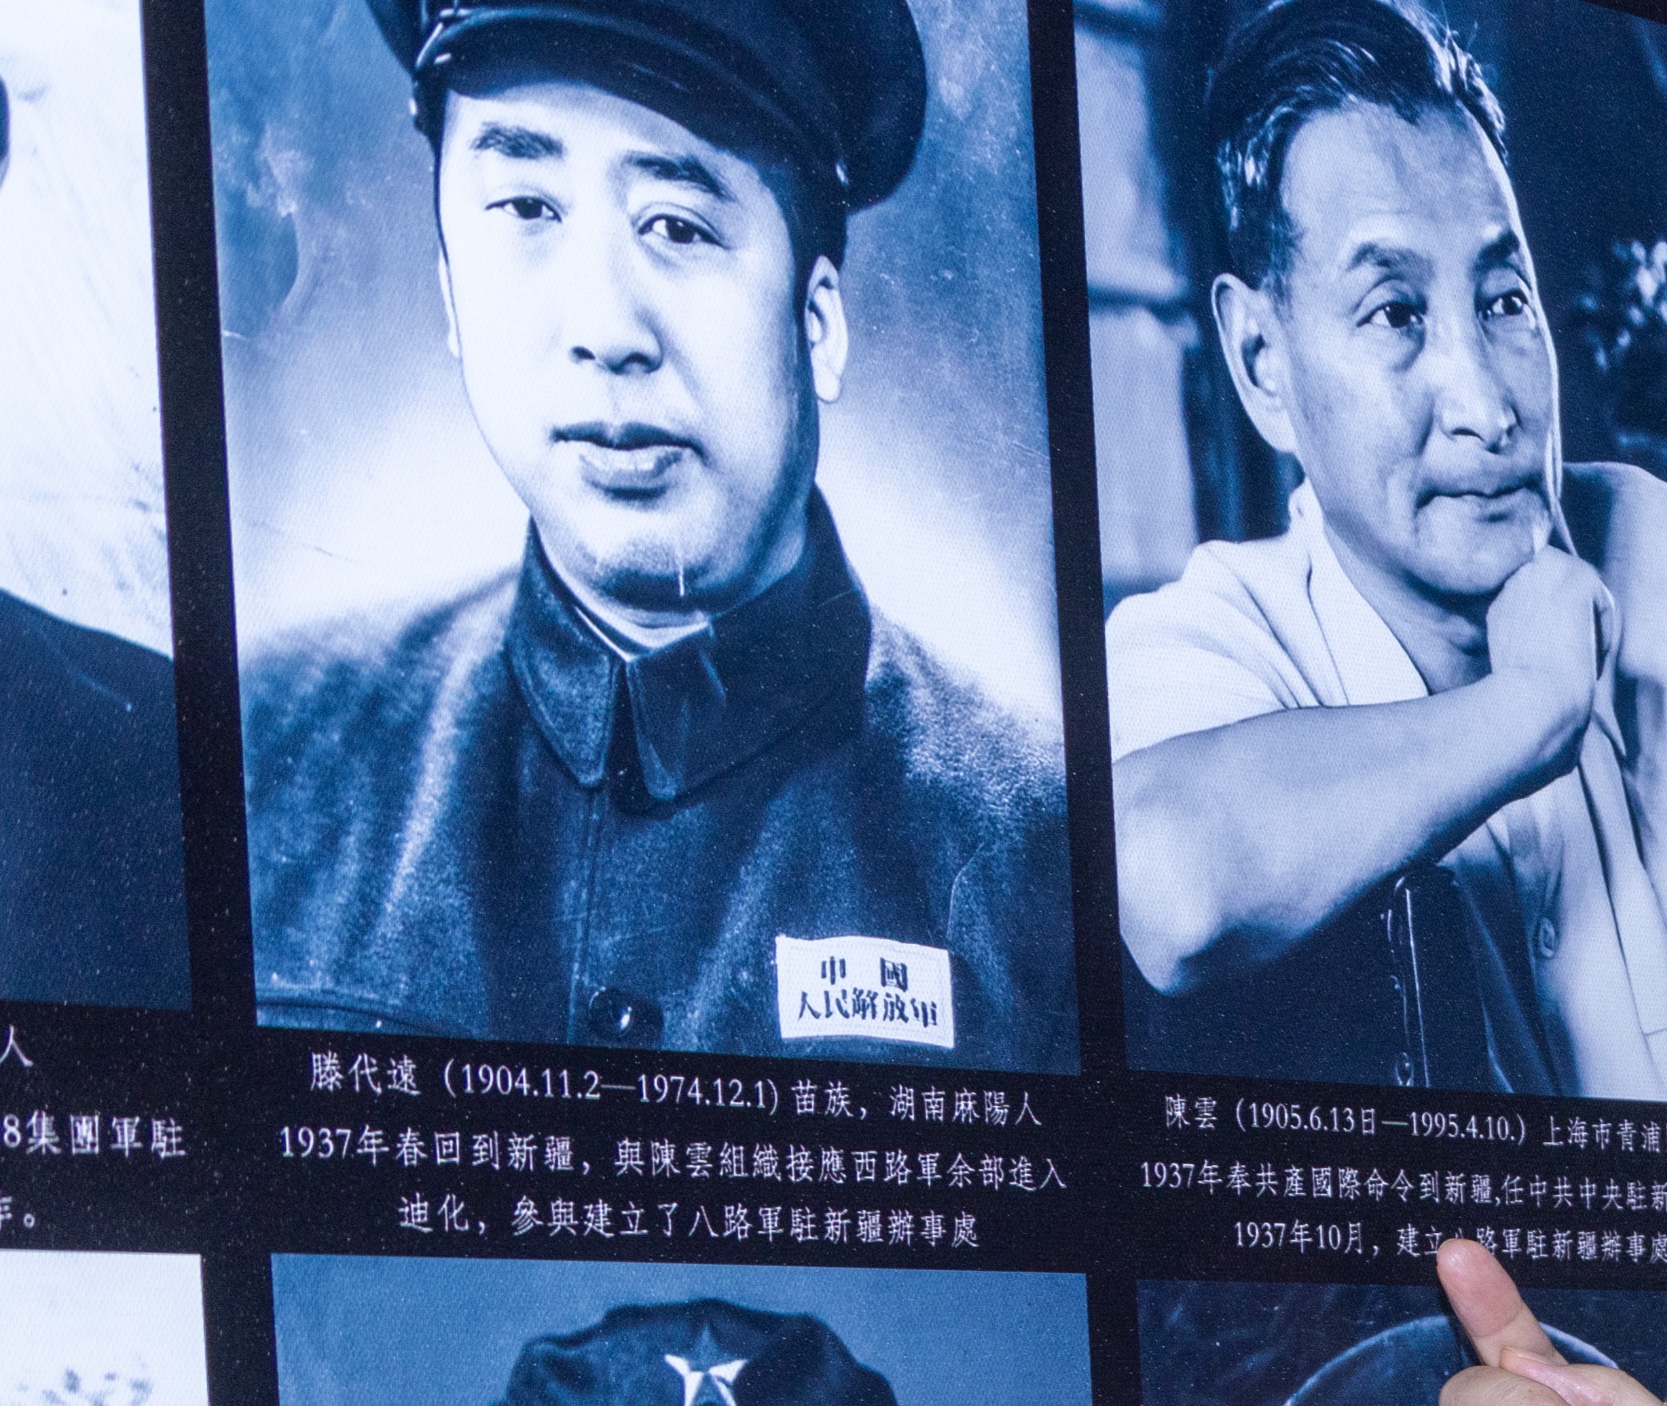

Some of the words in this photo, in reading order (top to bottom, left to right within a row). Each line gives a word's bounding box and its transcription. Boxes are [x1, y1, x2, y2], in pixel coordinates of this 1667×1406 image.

[797, 986, 938, 1028] 人民解放軍
